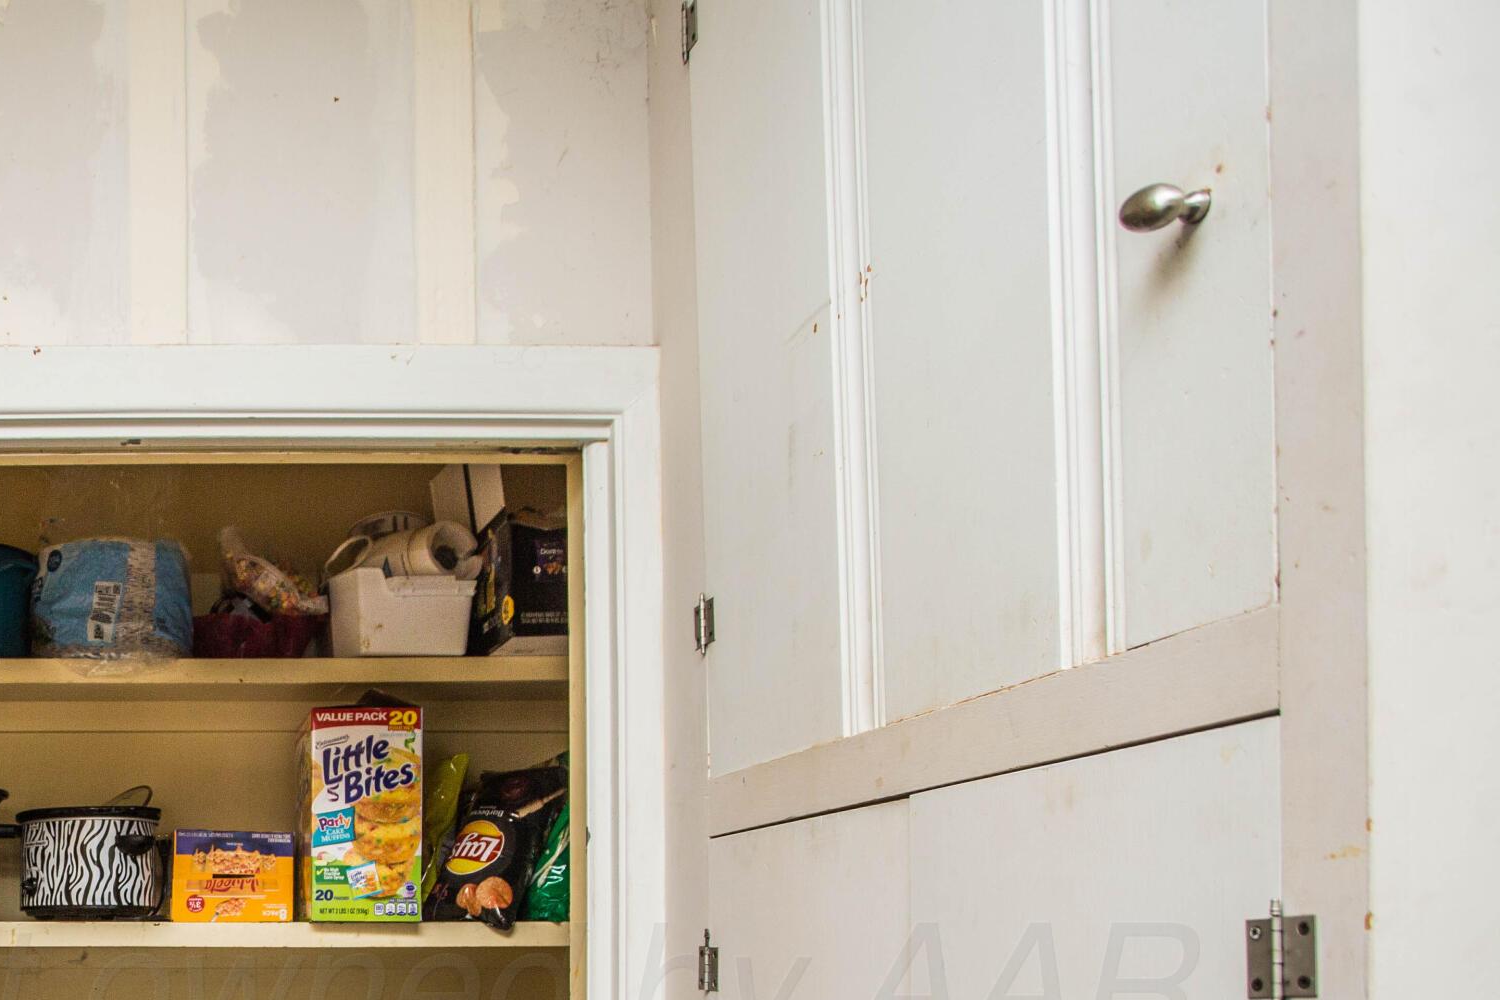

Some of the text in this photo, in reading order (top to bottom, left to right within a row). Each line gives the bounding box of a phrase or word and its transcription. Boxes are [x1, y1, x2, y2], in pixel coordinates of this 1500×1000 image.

[315, 710, 418, 726] VALUE PACK 20
[323, 734, 390, 786] Little
[344, 763, 414, 804] Bites
[315, 889, 334, 901] 20
[279, 908, 287, 920] 8
